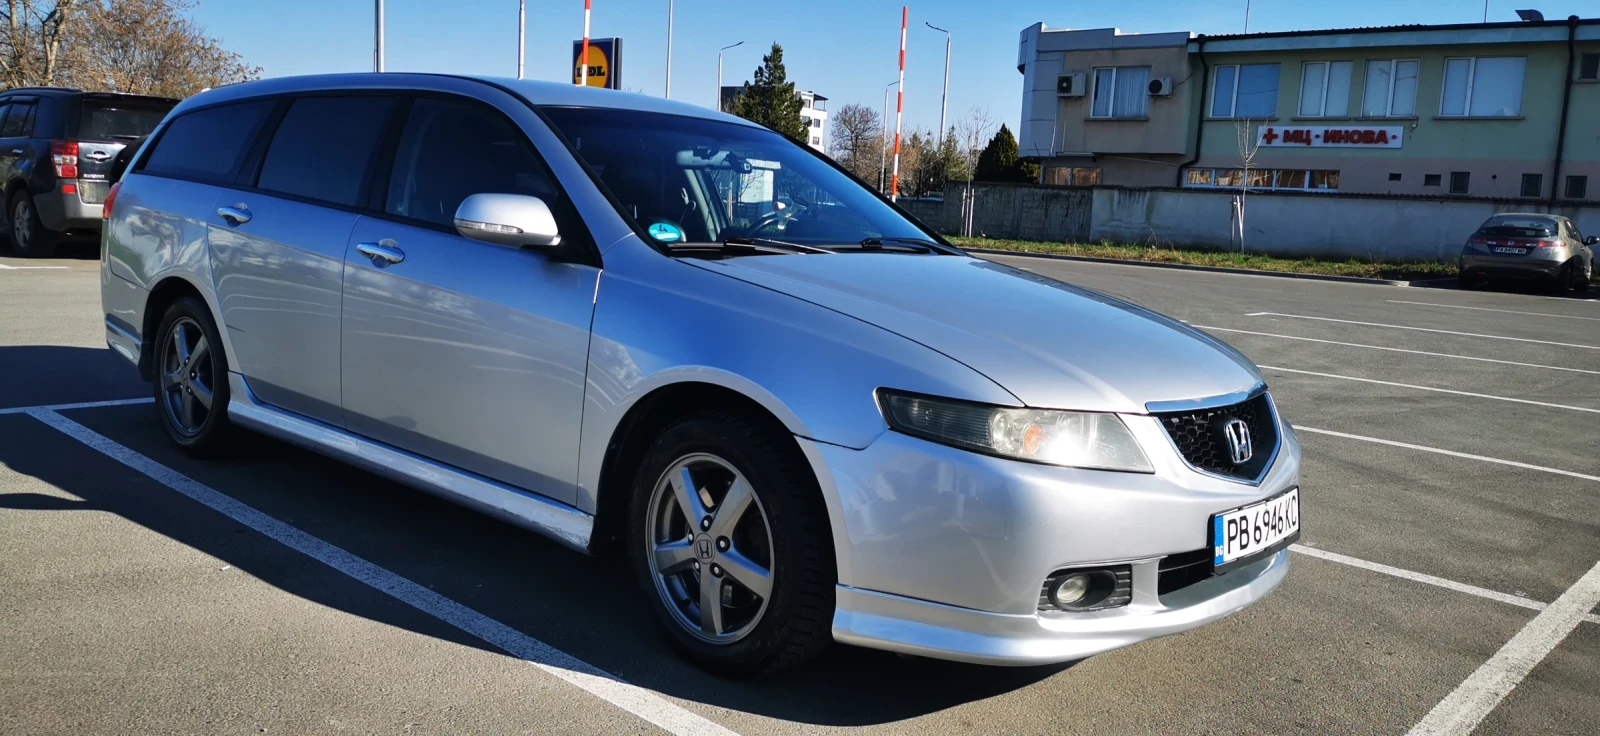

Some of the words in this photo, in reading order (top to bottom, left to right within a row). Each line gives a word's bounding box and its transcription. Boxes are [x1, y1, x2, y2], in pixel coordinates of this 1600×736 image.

[577, 66, 605, 77] LDL
[1283, 130, 1311, 145] МЦ
[1323, 130, 1388, 144] ИНОВА
[659, 224, 668, 232] 4
[1227, 515, 1250, 554] PB
[1253, 502, 1284, 544] 6946
[1285, 495, 1297, 531] KC
[1215, 545, 1223, 557] BG
